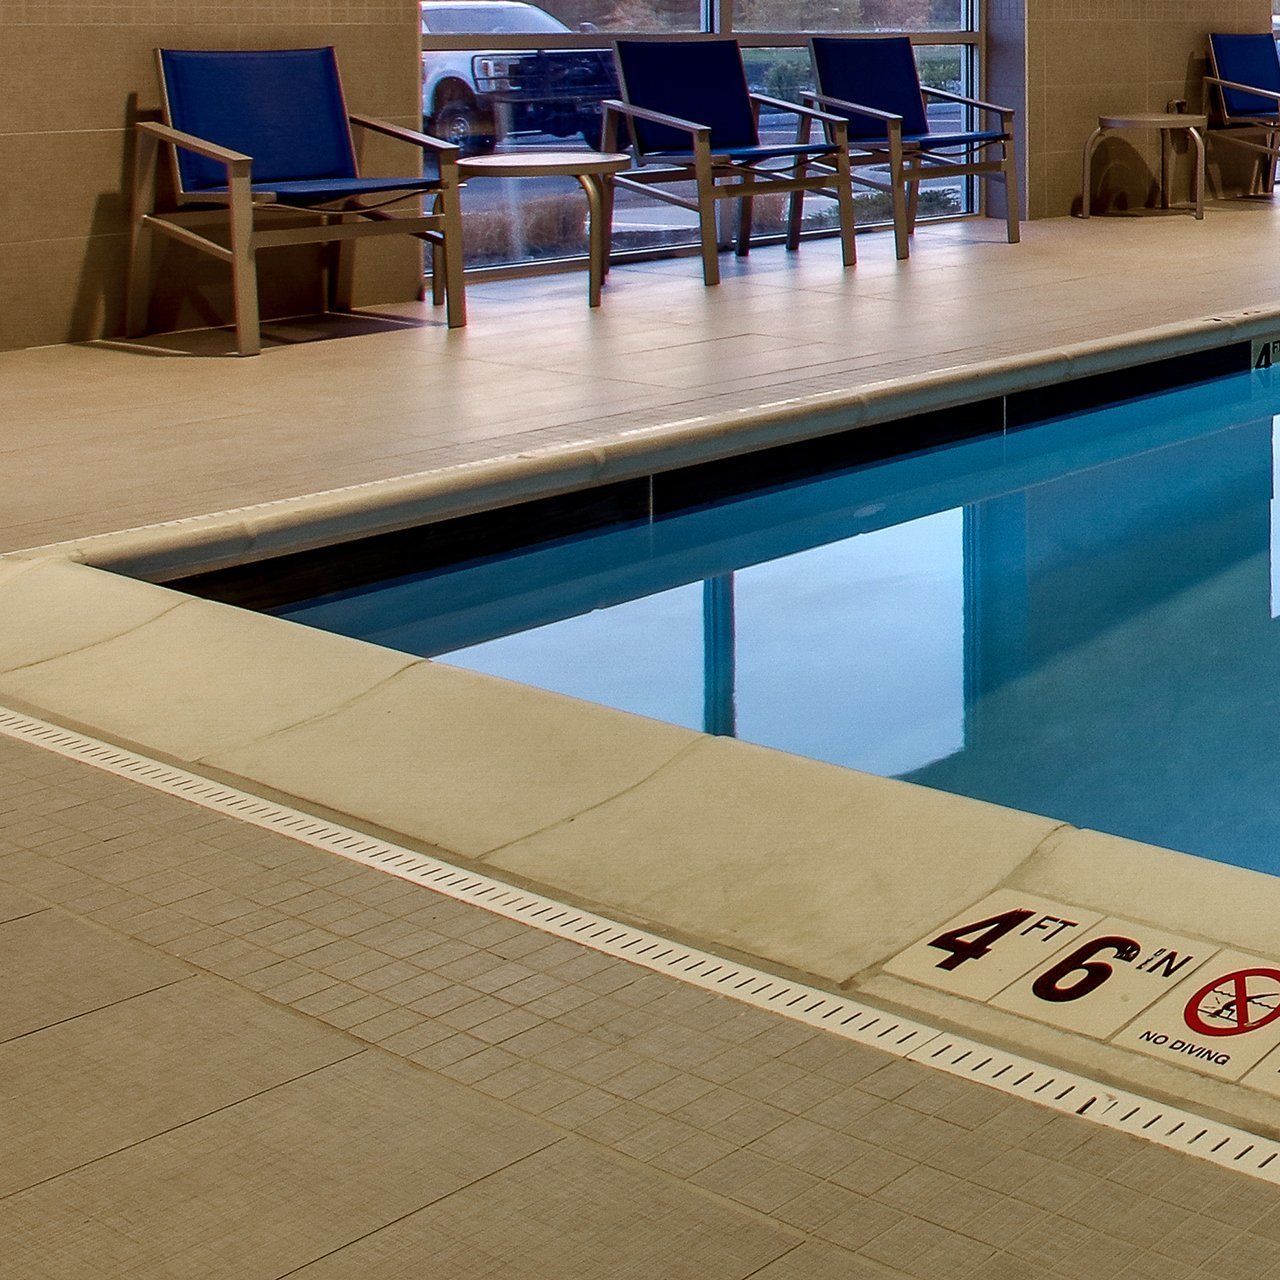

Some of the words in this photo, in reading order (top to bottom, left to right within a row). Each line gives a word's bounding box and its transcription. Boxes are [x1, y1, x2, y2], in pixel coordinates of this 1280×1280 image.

[1255, 342, 1272, 369] 4
[927, 908, 1037, 971] 4
[1020, 916, 1079, 942] FT
[1032, 935, 1141, 1002] 6
[1139, 1030, 1169, 1045] NO
[1169, 1039, 1231, 1066] DIVING
